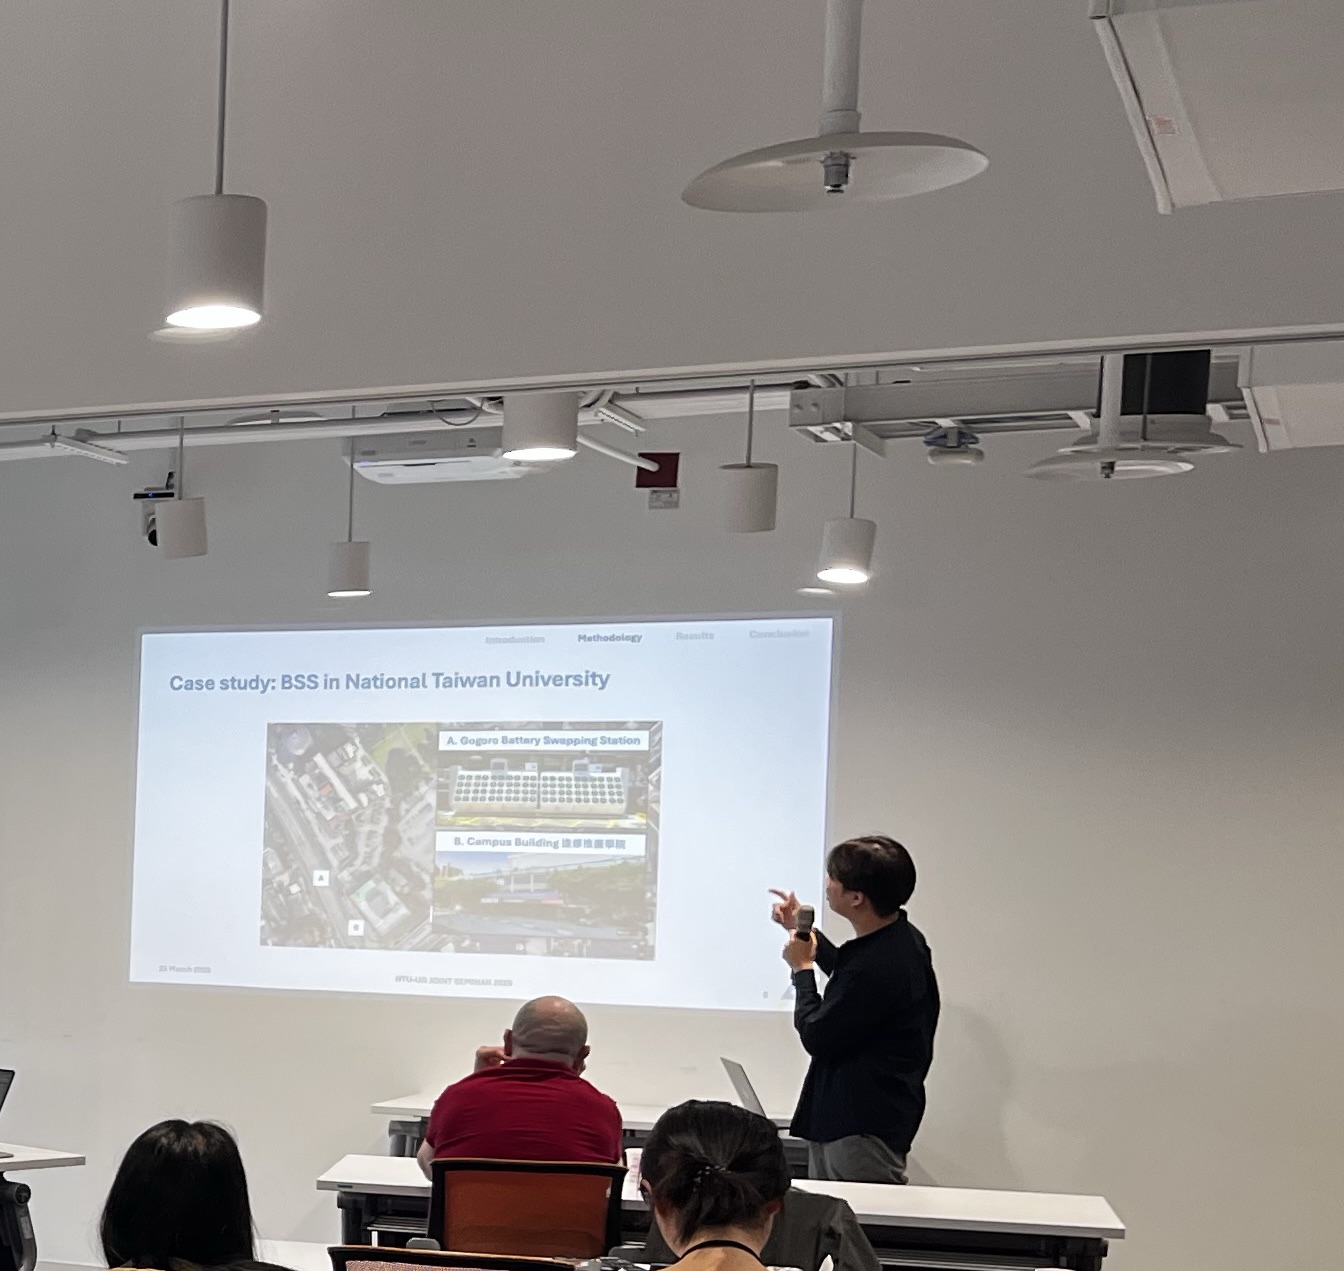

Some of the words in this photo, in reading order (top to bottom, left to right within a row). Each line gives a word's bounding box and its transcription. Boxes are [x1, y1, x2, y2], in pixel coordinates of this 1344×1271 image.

[577, 633, 643, 643] Methodology
[675, 632, 714, 640] Results
[169, 675, 215, 691] Case
[219, 674, 276, 694] study:
[281, 674, 319, 690] BSS
[323, 673, 340, 690] in
[345, 672, 428, 690] National
[432, 671, 501, 689] Taiwan
[506, 670, 611, 691] University
[446, 737, 458, 745] A.
[460, 736, 499, 747] Gogoro
[501, 735, 541, 747] Battery
[543, 735, 598, 747] Swapping
[599, 736, 641, 745] Station
[454, 837, 464, 846] B.
[467, 837, 512, 848] Campus
[514, 838, 559, 850] Building
